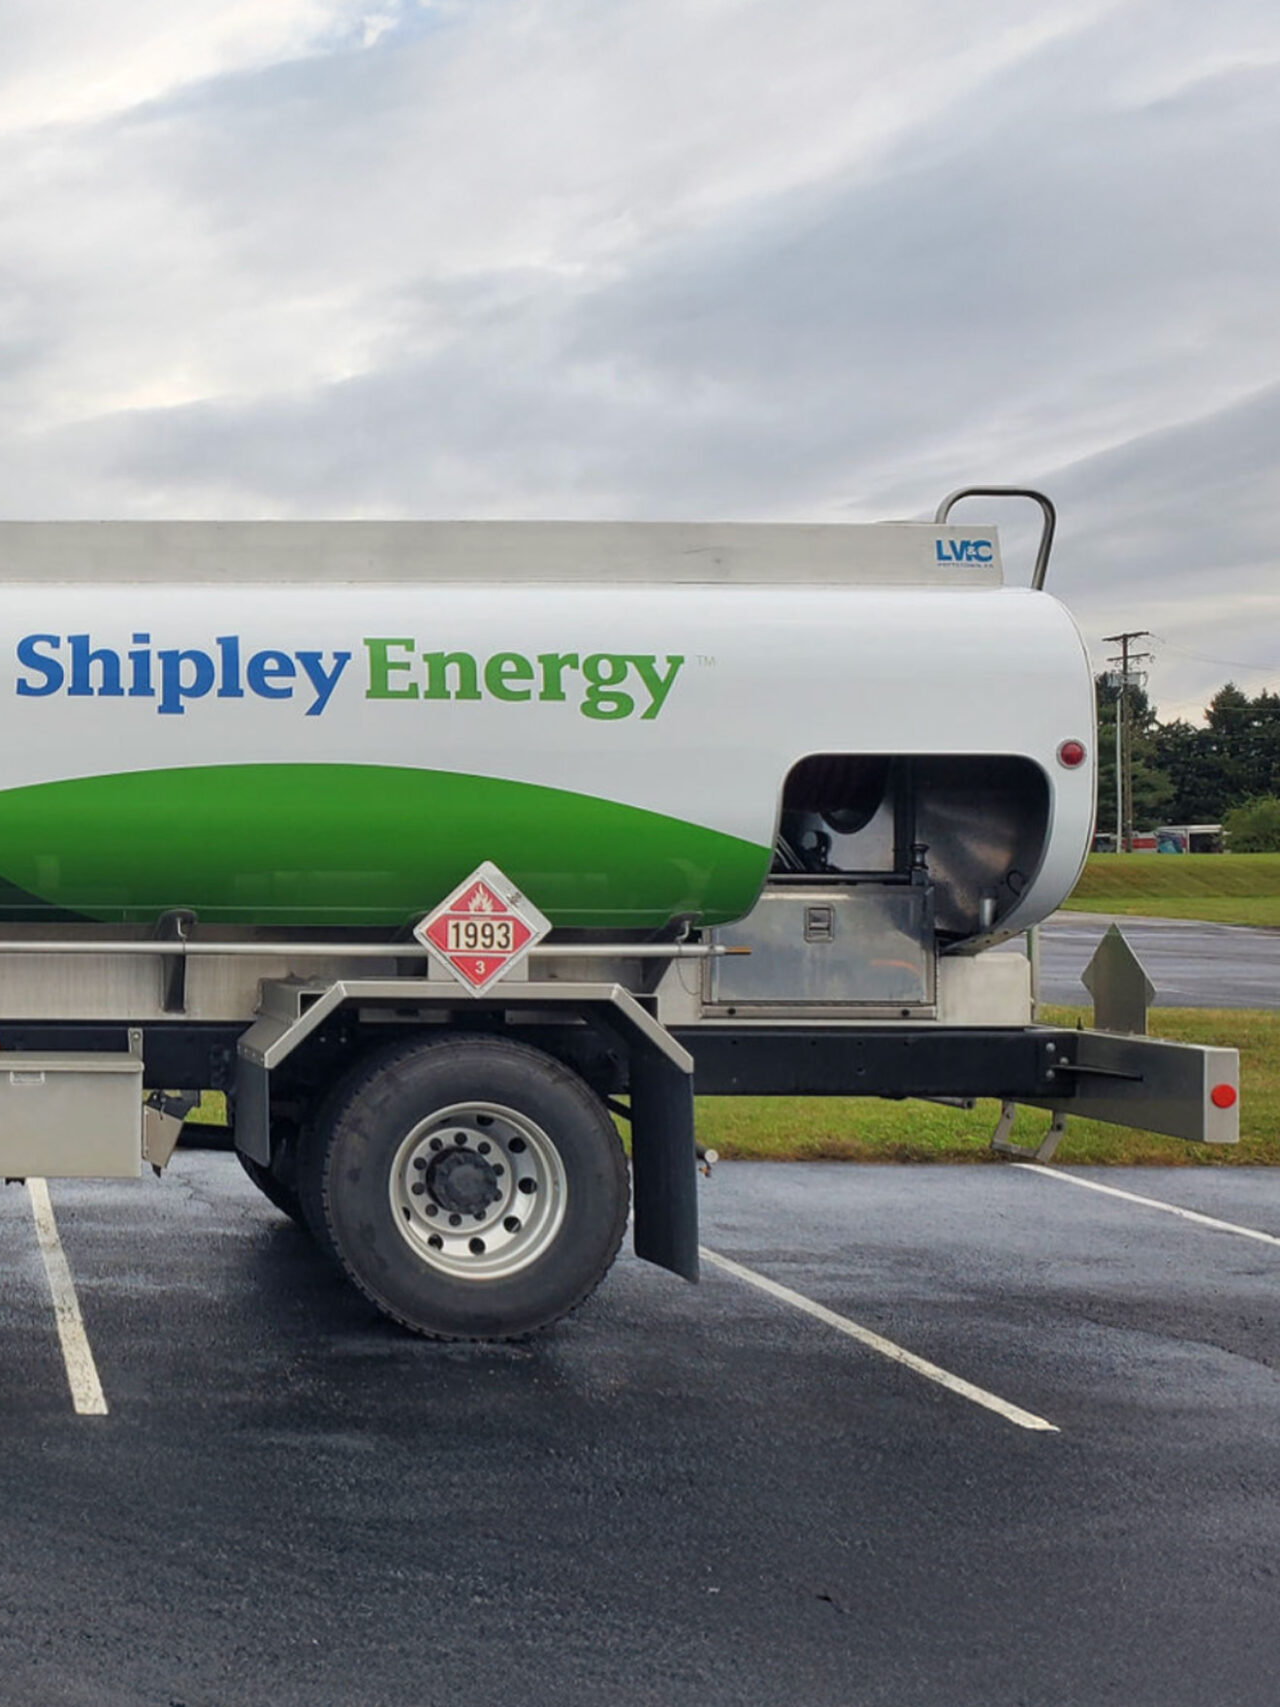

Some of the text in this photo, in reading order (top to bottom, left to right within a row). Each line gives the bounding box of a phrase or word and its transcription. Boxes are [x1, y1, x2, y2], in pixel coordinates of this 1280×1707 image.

[16, 632, 352, 716] Shipley
[363, 637, 685, 720] Energy
[451, 922, 511, 949] 1993
[475, 960, 485, 974] 3
